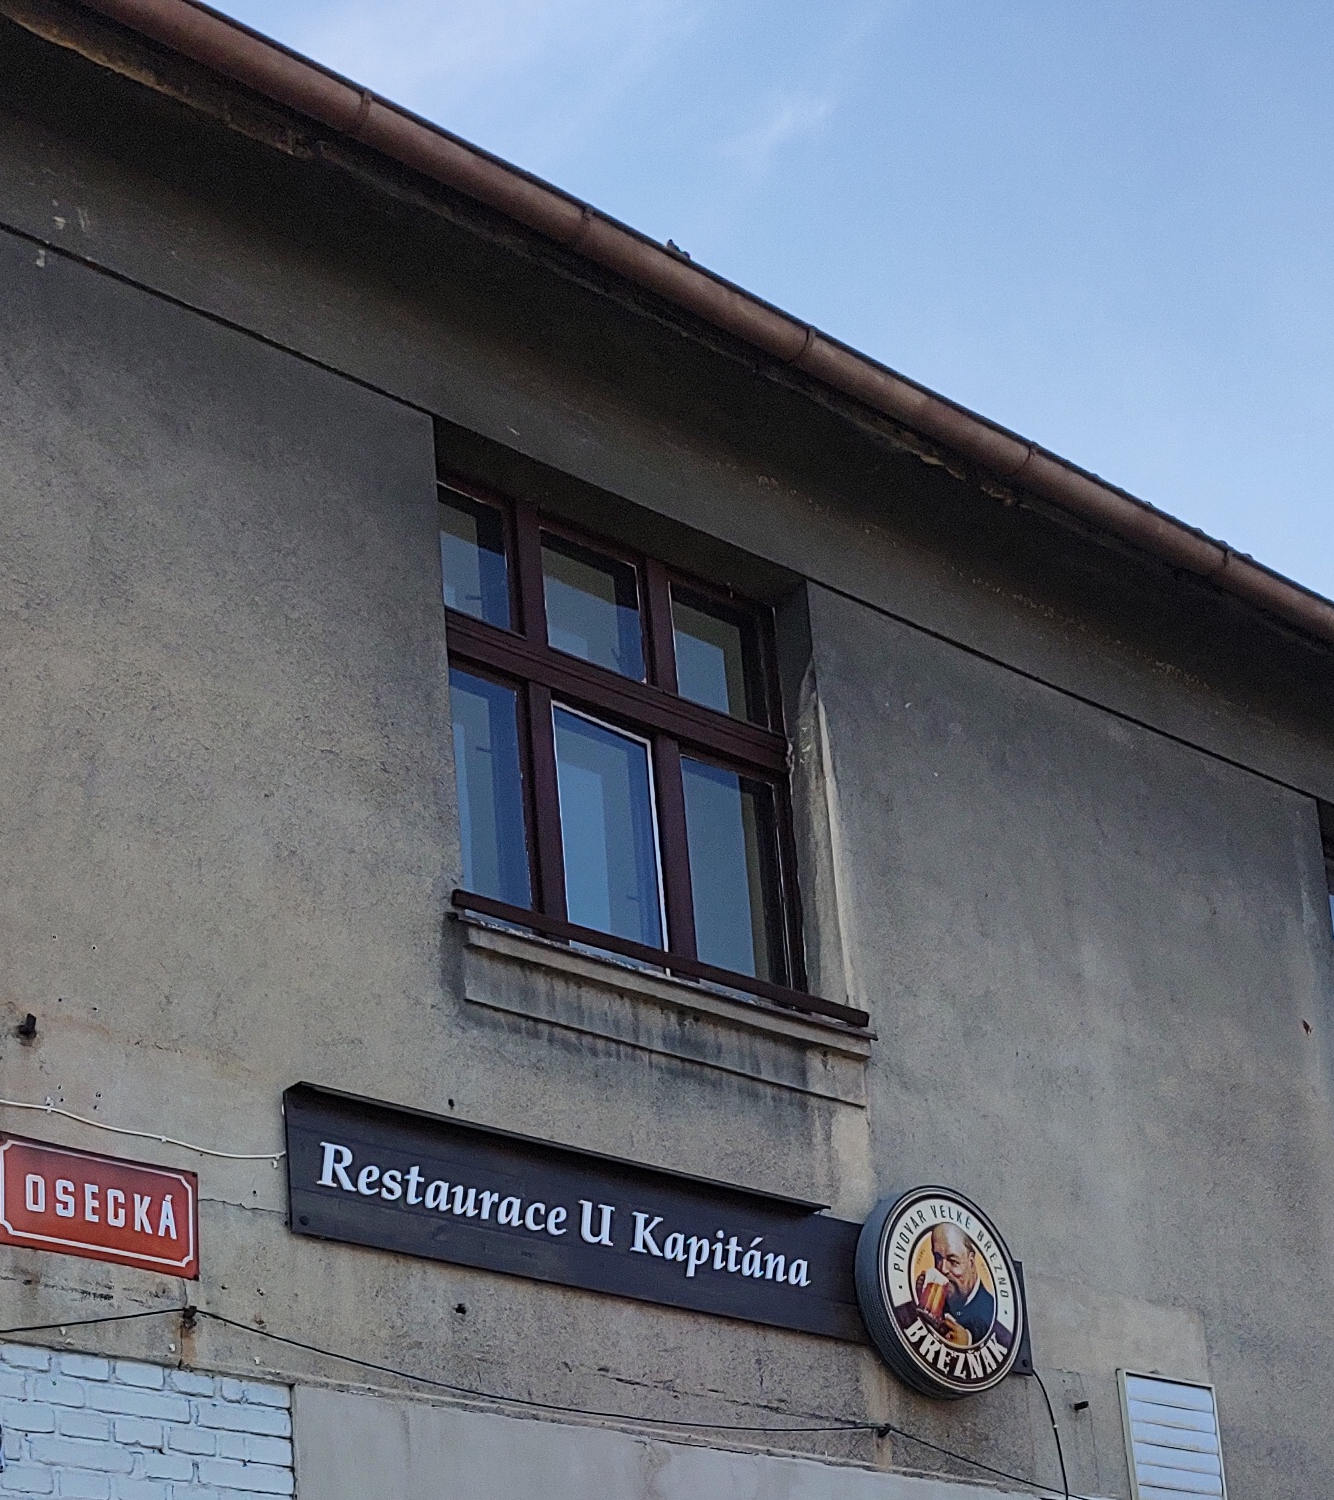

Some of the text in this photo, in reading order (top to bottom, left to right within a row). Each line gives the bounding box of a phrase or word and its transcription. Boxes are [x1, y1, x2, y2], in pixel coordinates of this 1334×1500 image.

[25, 1173, 178, 1240] OSECKÁ
[317, 1141, 812, 1287] Restaurace U Kapitána
[893, 1205, 1010, 1299] PIVOVAR VELKÉ BŘEZNO
[904, 1317, 1009, 1380] BŘEZŇÁK
